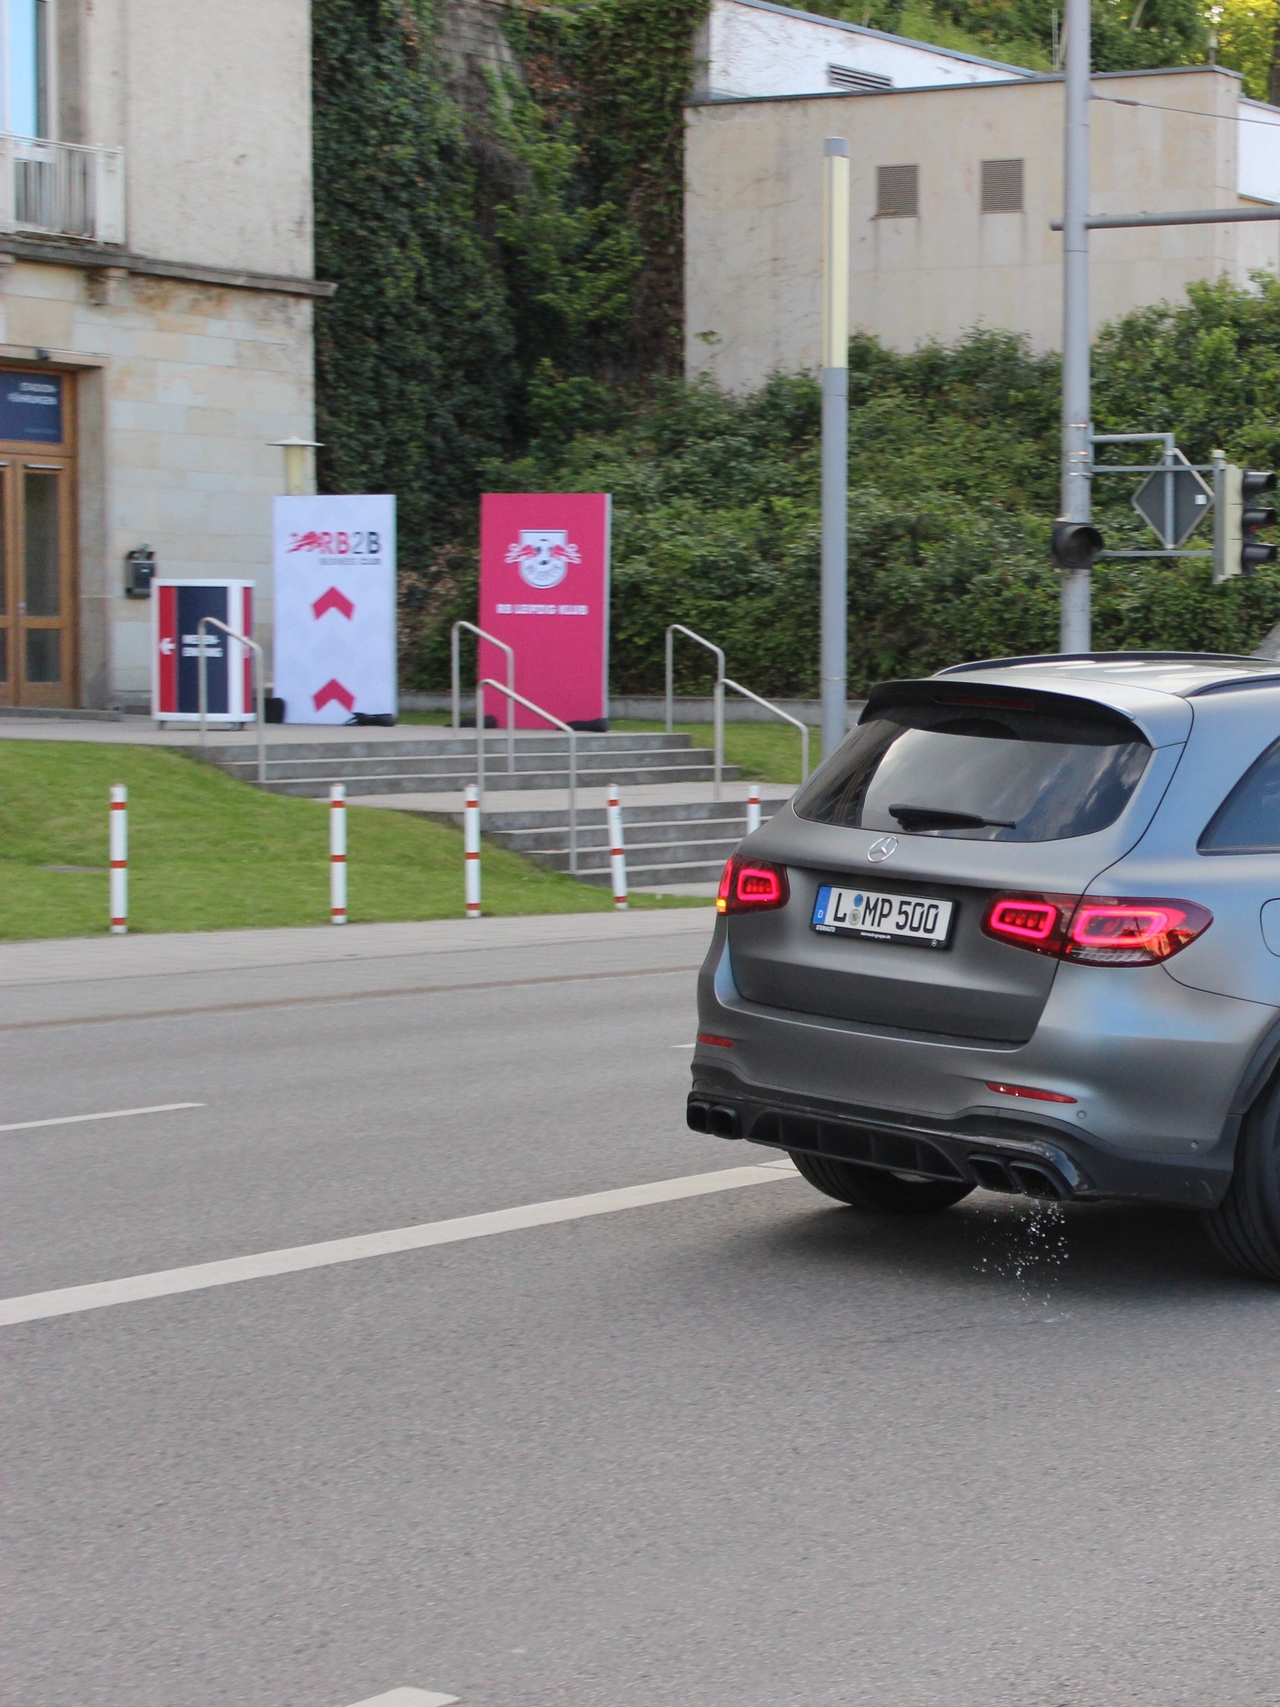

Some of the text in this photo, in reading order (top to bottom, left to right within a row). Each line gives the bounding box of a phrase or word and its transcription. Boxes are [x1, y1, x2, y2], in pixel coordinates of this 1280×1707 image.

[319, 531, 381, 554] RB2B
[817, 909, 824, 919] D
[833, 892, 939, 934] L MP 500
